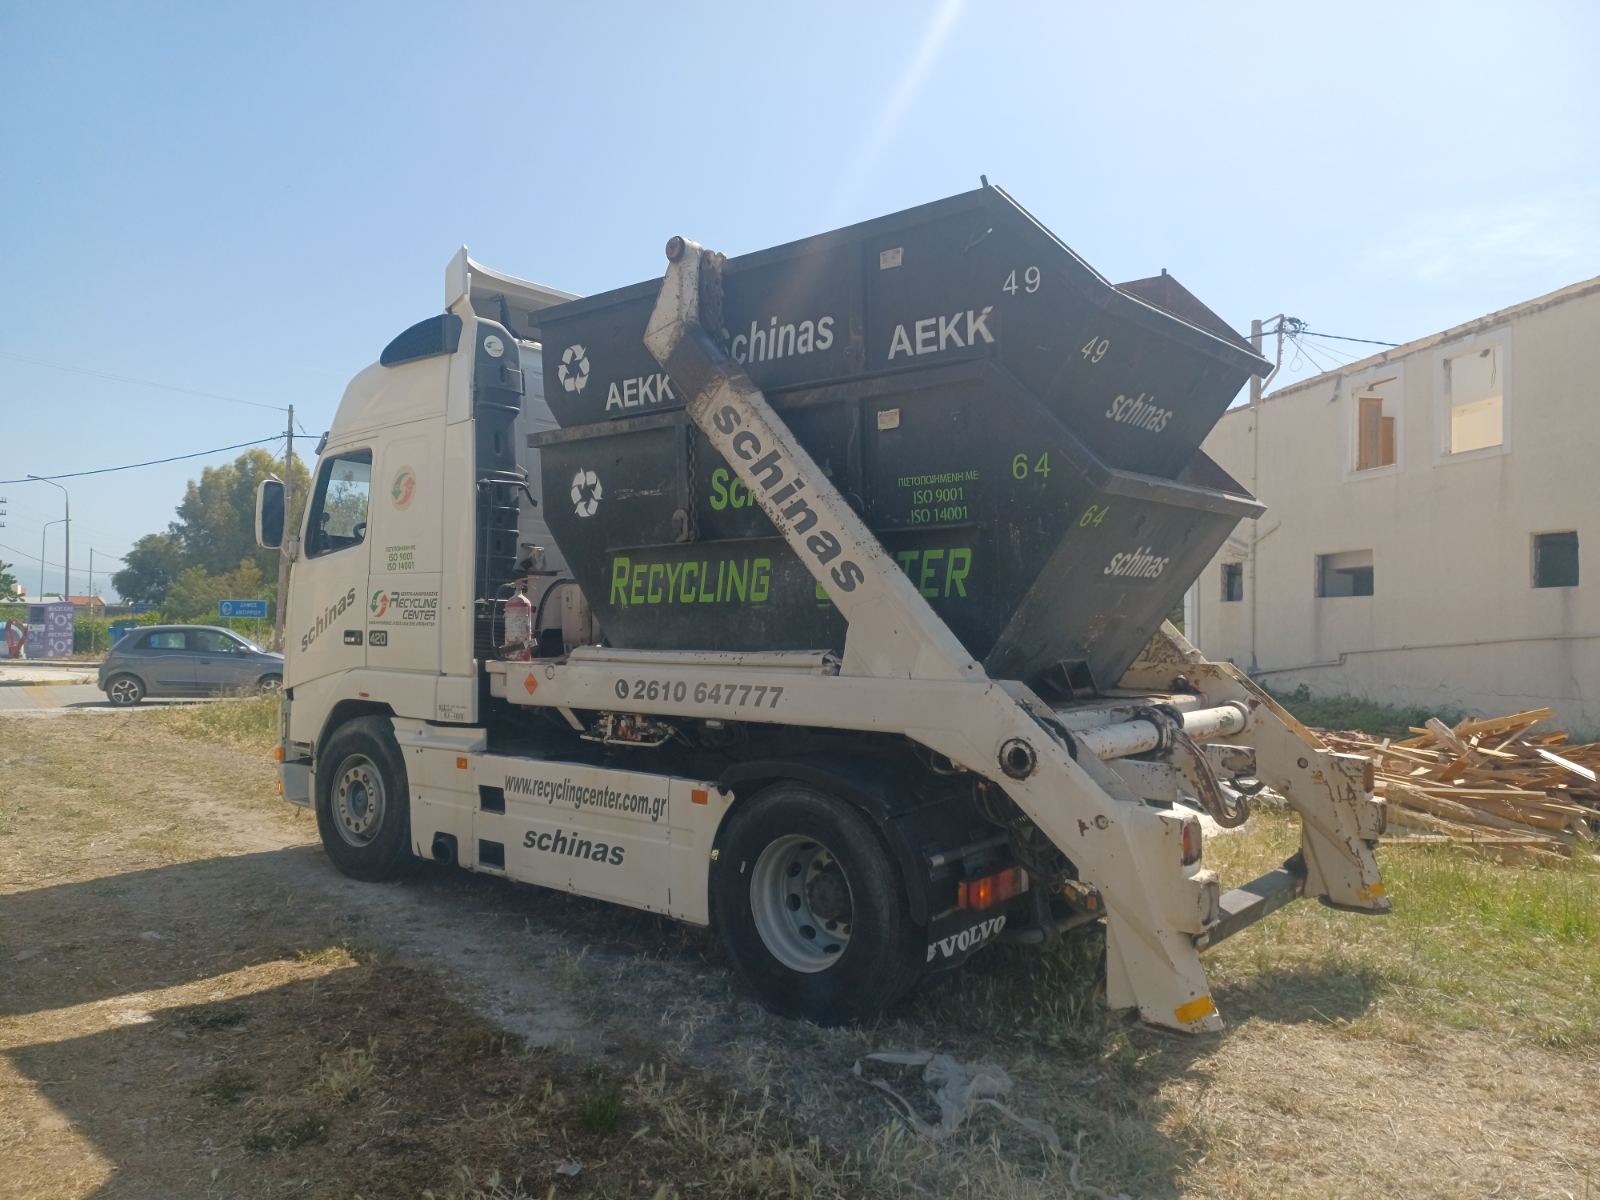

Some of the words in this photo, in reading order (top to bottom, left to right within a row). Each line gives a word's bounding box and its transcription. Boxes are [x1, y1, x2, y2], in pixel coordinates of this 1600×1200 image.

[1002, 266, 1041, 295] 49
[1081, 336, 1110, 363] 49
[1105, 393, 1173, 433] schinas
[1012, 452, 1051, 480] 64
[712, 404, 865, 592] schinas
[913, 489, 933, 505] ISO
[935, 487, 964, 503] 9001
[911, 508, 930, 524] ISO
[933, 505, 968, 522] 14001
[1079, 504, 1110, 528] 64
[1104, 545, 1170, 578] schinas
[609, 557, 772, 606] RECYCLING
[301, 587, 356, 653] schinas
[402, 609, 437, 621] CENTER
[370, 632, 386, 645] 420
[633, 679, 687, 703] 2610
[694, 682, 785, 709] 647777
[504, 775, 667, 822] www.recyclingcenter.com.gr
[523, 829, 626, 866] schinas
[937, 915, 1007, 958] VOLVO
